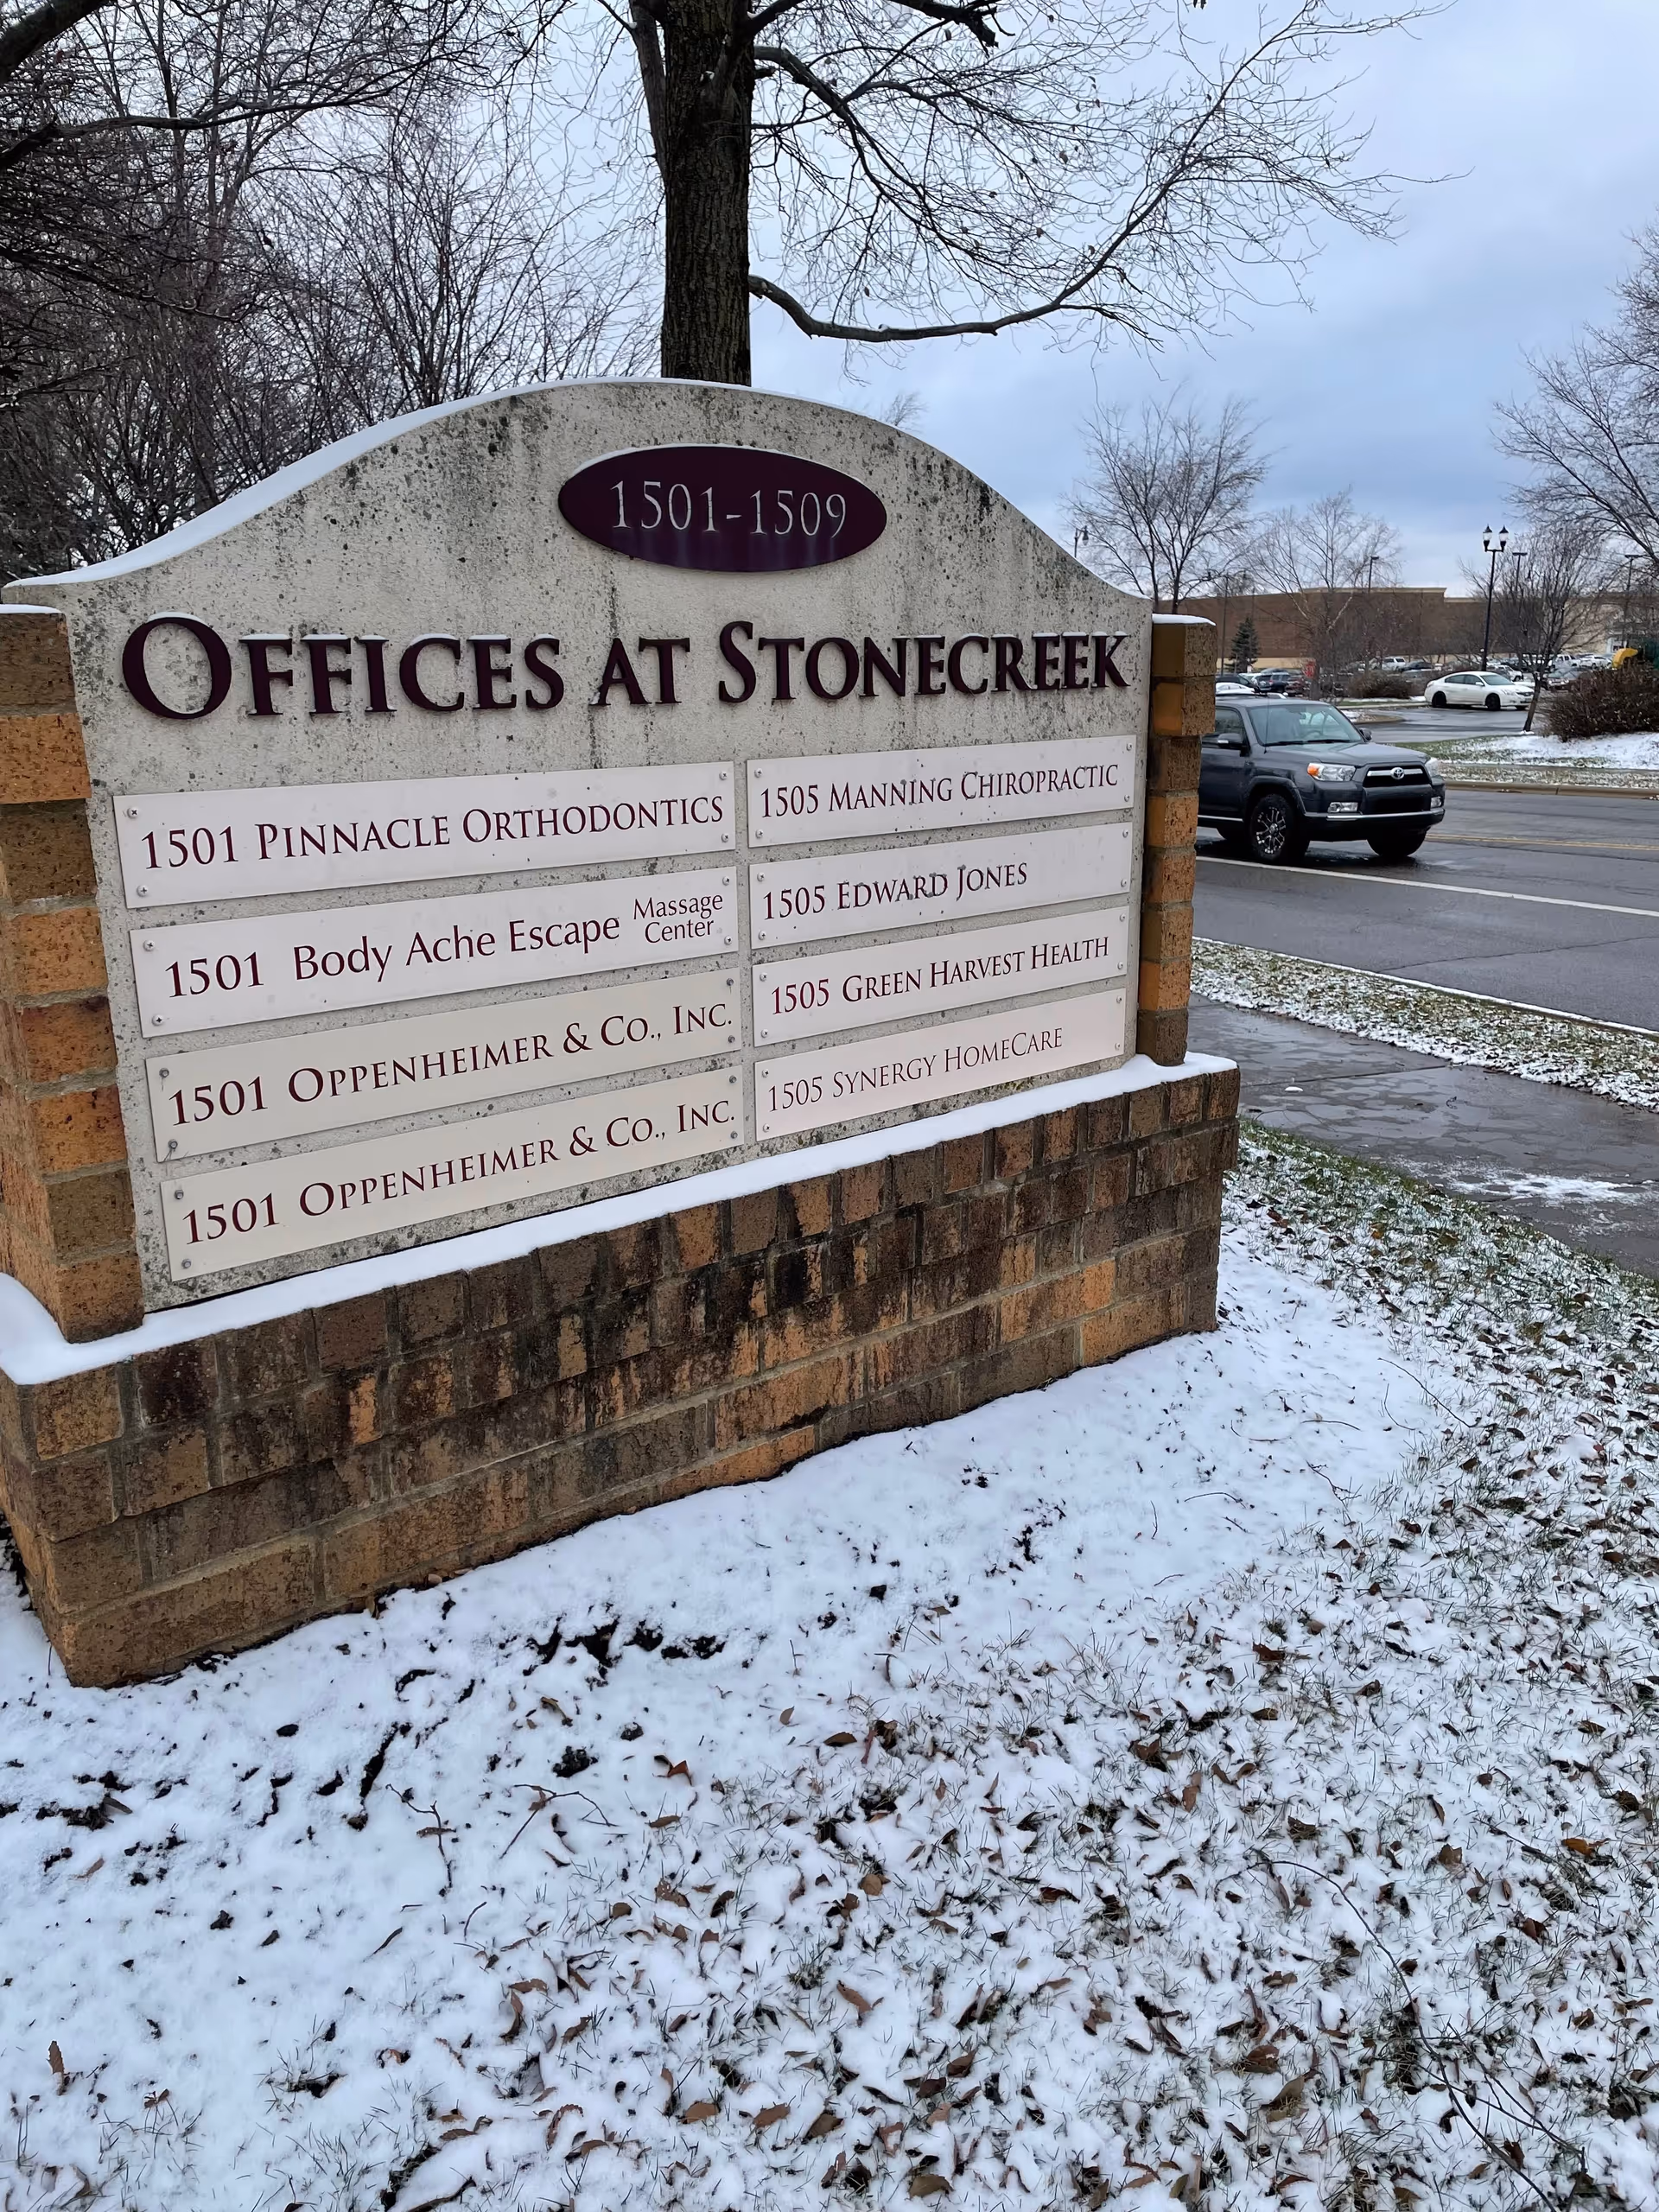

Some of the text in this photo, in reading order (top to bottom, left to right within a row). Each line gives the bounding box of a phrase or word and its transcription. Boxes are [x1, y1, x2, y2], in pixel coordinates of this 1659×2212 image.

[610, 479, 847, 538] 1501-1509
[121, 613, 1131, 719] OFFICES AT STONECREEK
[760, 764, 1119, 817] 1505 MANNING CHIROPRACTIC
[141, 795, 724, 869] 1501 PINNACLE ORTHODONTICS
[632, 893, 724, 919] Massage
[762, 862, 1028, 920] 1505 EDWARD JONES
[165, 916, 620, 998] 1501 Body Ache Escape
[644, 917, 715, 944] Center
[771, 937, 1109, 1015] 1505 GREEN HARVEST HEALTH
[168, 1075, 269, 1126] 1501
[288, 1034, 553, 1103] OPPENHEIMER
[562, 1022, 592, 1054] &
[673, 1002, 734, 1035] INC.
[767, 1077, 823, 1112] 1505
[832, 1054, 938, 1098] SYNERGY
[182, 1193, 282, 1245] 1501
[299, 1139, 561, 1217] OPPENHEIMER
[569, 1126, 598, 1157] &
[677, 1099, 735, 1135] INC.
